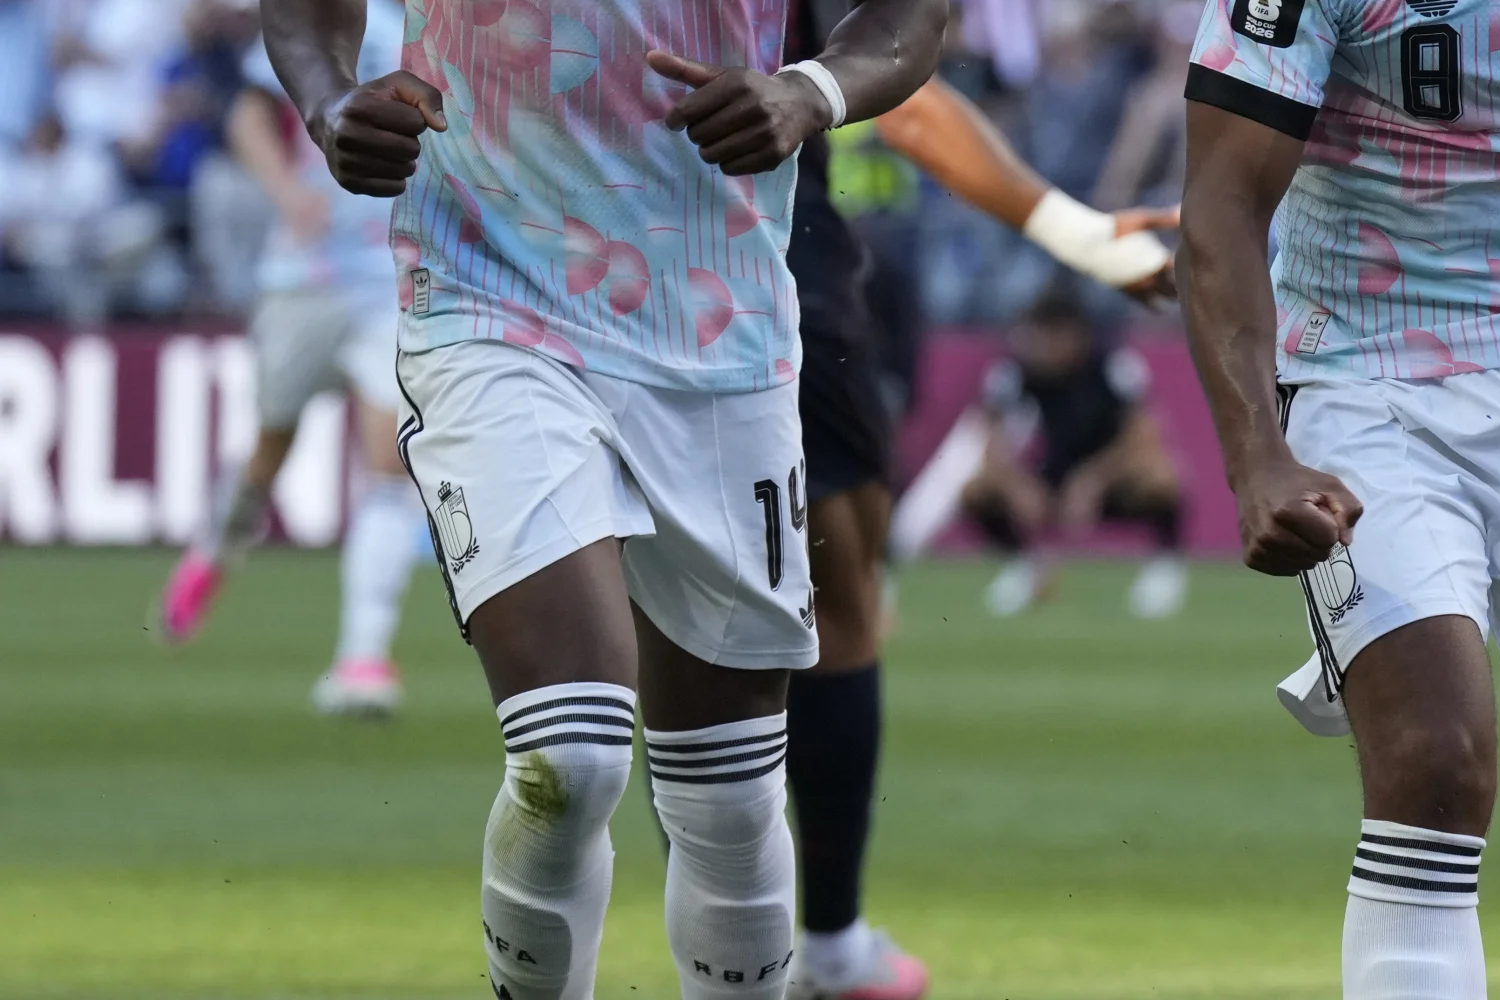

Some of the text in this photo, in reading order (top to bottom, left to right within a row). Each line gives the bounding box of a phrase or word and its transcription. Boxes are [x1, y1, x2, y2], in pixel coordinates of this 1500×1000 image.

[1244, 21, 1275, 39] 2026
[1263, 22, 1277, 30] CUP
[1400, 23, 1463, 123] 8
